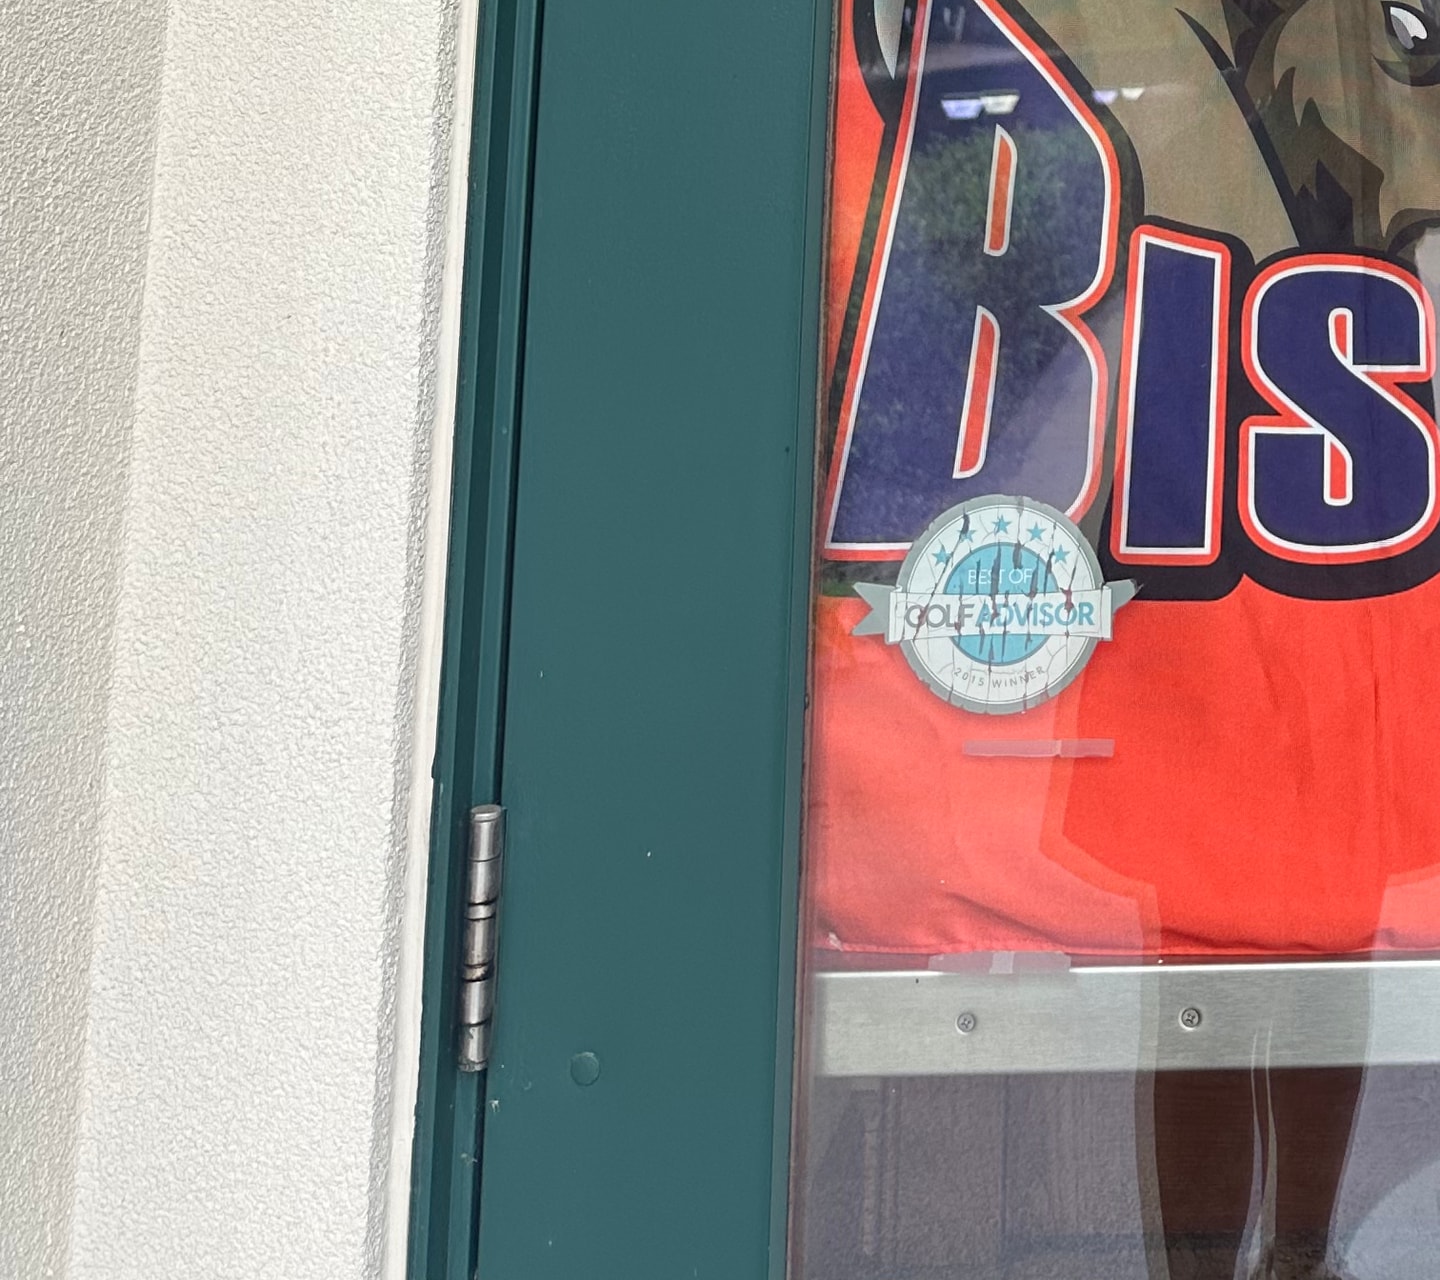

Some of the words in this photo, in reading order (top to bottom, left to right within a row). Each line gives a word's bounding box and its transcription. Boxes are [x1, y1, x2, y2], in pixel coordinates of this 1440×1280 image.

[968, 568, 1005, 585] BEST
[1008, 568, 1033, 584] OF
[953, 667, 984, 687] 2015
[992, 666, 1046, 689] WINNER
